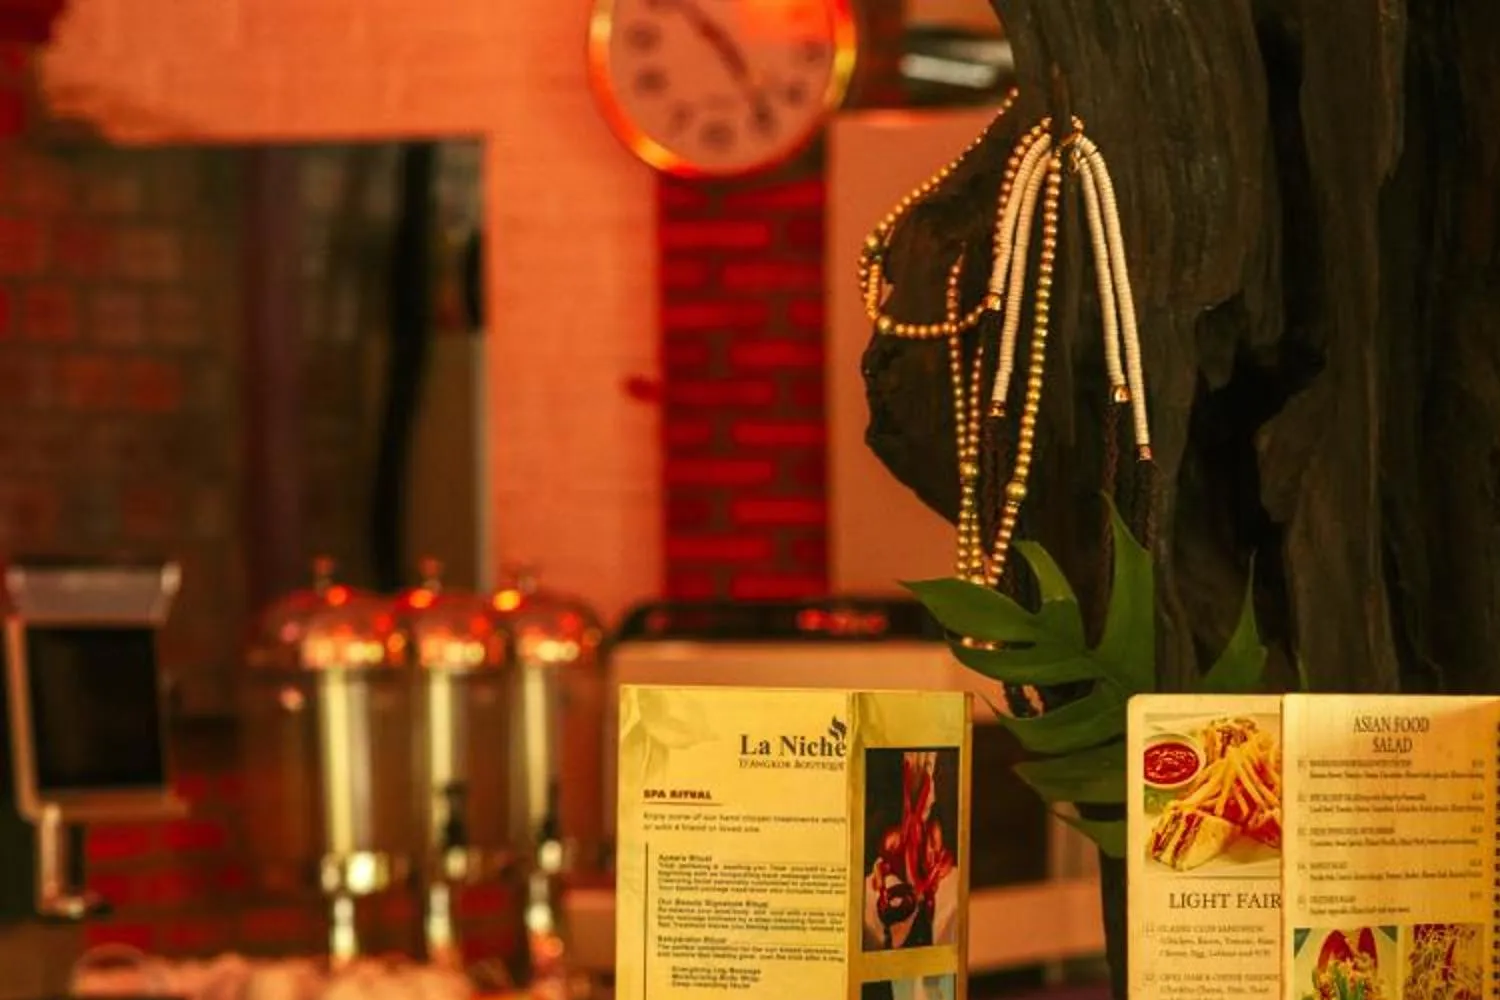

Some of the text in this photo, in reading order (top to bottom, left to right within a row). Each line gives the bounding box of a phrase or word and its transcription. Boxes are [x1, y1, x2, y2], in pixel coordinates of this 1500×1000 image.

[1353, 715, 1430, 733] ASIAN FOOD
[739, 733, 847, 757] La Niche
[1372, 736, 1413, 753] SALAD
[643, 789, 712, 800] SPA RITUAL
[1168, 893, 1231, 909] LIGHT
